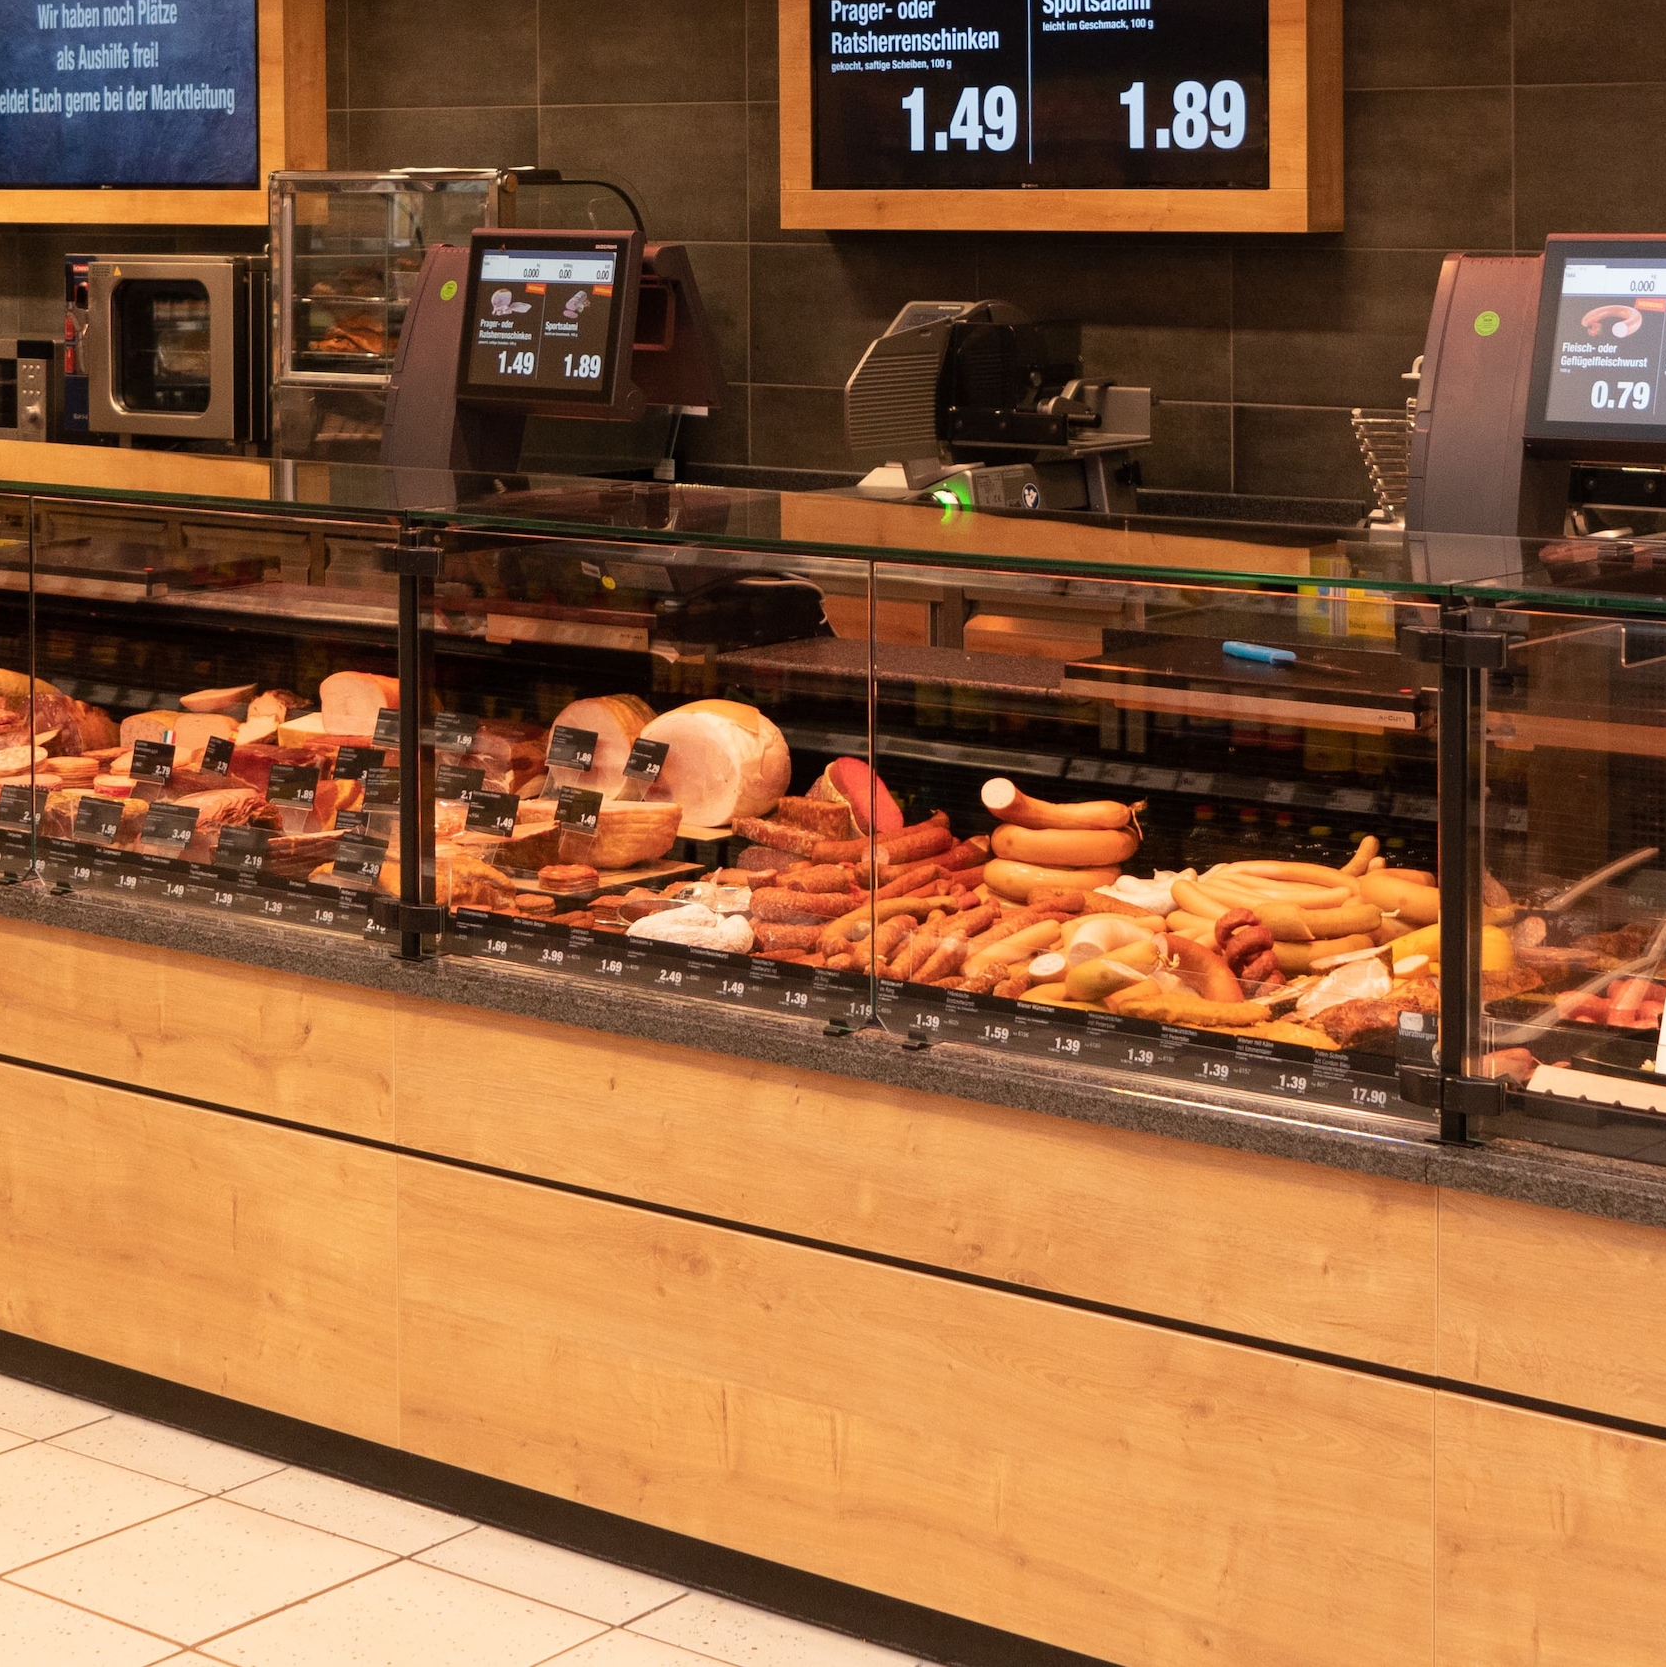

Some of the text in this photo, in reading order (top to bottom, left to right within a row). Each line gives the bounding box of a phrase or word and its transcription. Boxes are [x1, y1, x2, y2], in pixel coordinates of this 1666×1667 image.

[37, 0, 178, 30] Wir haben noch Plätze
[831, 0, 892, 27] Prager-
[1042, 18, 1154, 32] leicht im Geschmack, 100 g
[831, 27, 1000, 56] Ratsherrenschinken
[57, 41, 159, 71] als Aushilfe frei!
[831, 58, 952, 73] gekocht, saftige Scheiben, 100 g
[32, 87, 61, 113] Euch
[65, 91, 101, 118] gerne
[104, 85, 123, 111] bei
[127, 85, 148, 111] der
[151, 83, 235, 115] Marktleitung
[902, 85, 1018, 152] 1.49
[1120, 79, 1246, 150] 1.89
[1629, 280, 1655, 293] 0,000
[1562, 342, 1617, 354] Fleisch- oder
[498, 350, 535, 375] 1.49
[564, 353, 602, 378] 1.89
[1560, 355, 1648, 368] Geflügelfleischwurst
[1590, 381, 1650, 410] 0.79
[456, 734, 473, 745] 1.99
[155, 765, 171, 775] 2.79
[296, 789, 314, 799] 1.89
[23, 811, 41, 822] 2.9
[496, 816, 513, 828] 1.49
[580, 813, 596, 825] 1.49
[101, 823, 117, 835] 1.99
[172, 828, 192, 840] 3.49
[29, 858, 46, 870] 169
[244, 854, 262, 867] 2.19
[73, 866, 91, 879] 1.99
[362, 862, 380, 875] 2.39
[119, 875, 137, 887] 1.99
[166, 883, 184, 895] 1.49
[214, 891, 233, 904] 1.39
[264, 900, 283, 913] 1.39
[315, 909, 334, 922] 1.99
[487, 938, 508, 953] 1.69
[542, 948, 564, 963] 3.99
[601, 959, 623, 973] 1.69
[660, 969, 682, 983] 2.49
[722, 980, 745, 994] 1.49
[785, 991, 808, 1005] 1.39
[849, 1002, 872, 1016] 1.19
[916, 1013, 940, 1028] 1.39
[984, 1025, 1009, 1040] 1.59
[1054, 1037, 1081, 1052] 1.39
[1127, 1048, 1154, 1063] 1.39
[1202, 1062, 1230, 1077] 1.39
[1279, 1074, 1307, 1091] 1.39
[1352, 1086, 1387, 1105] 17.90
